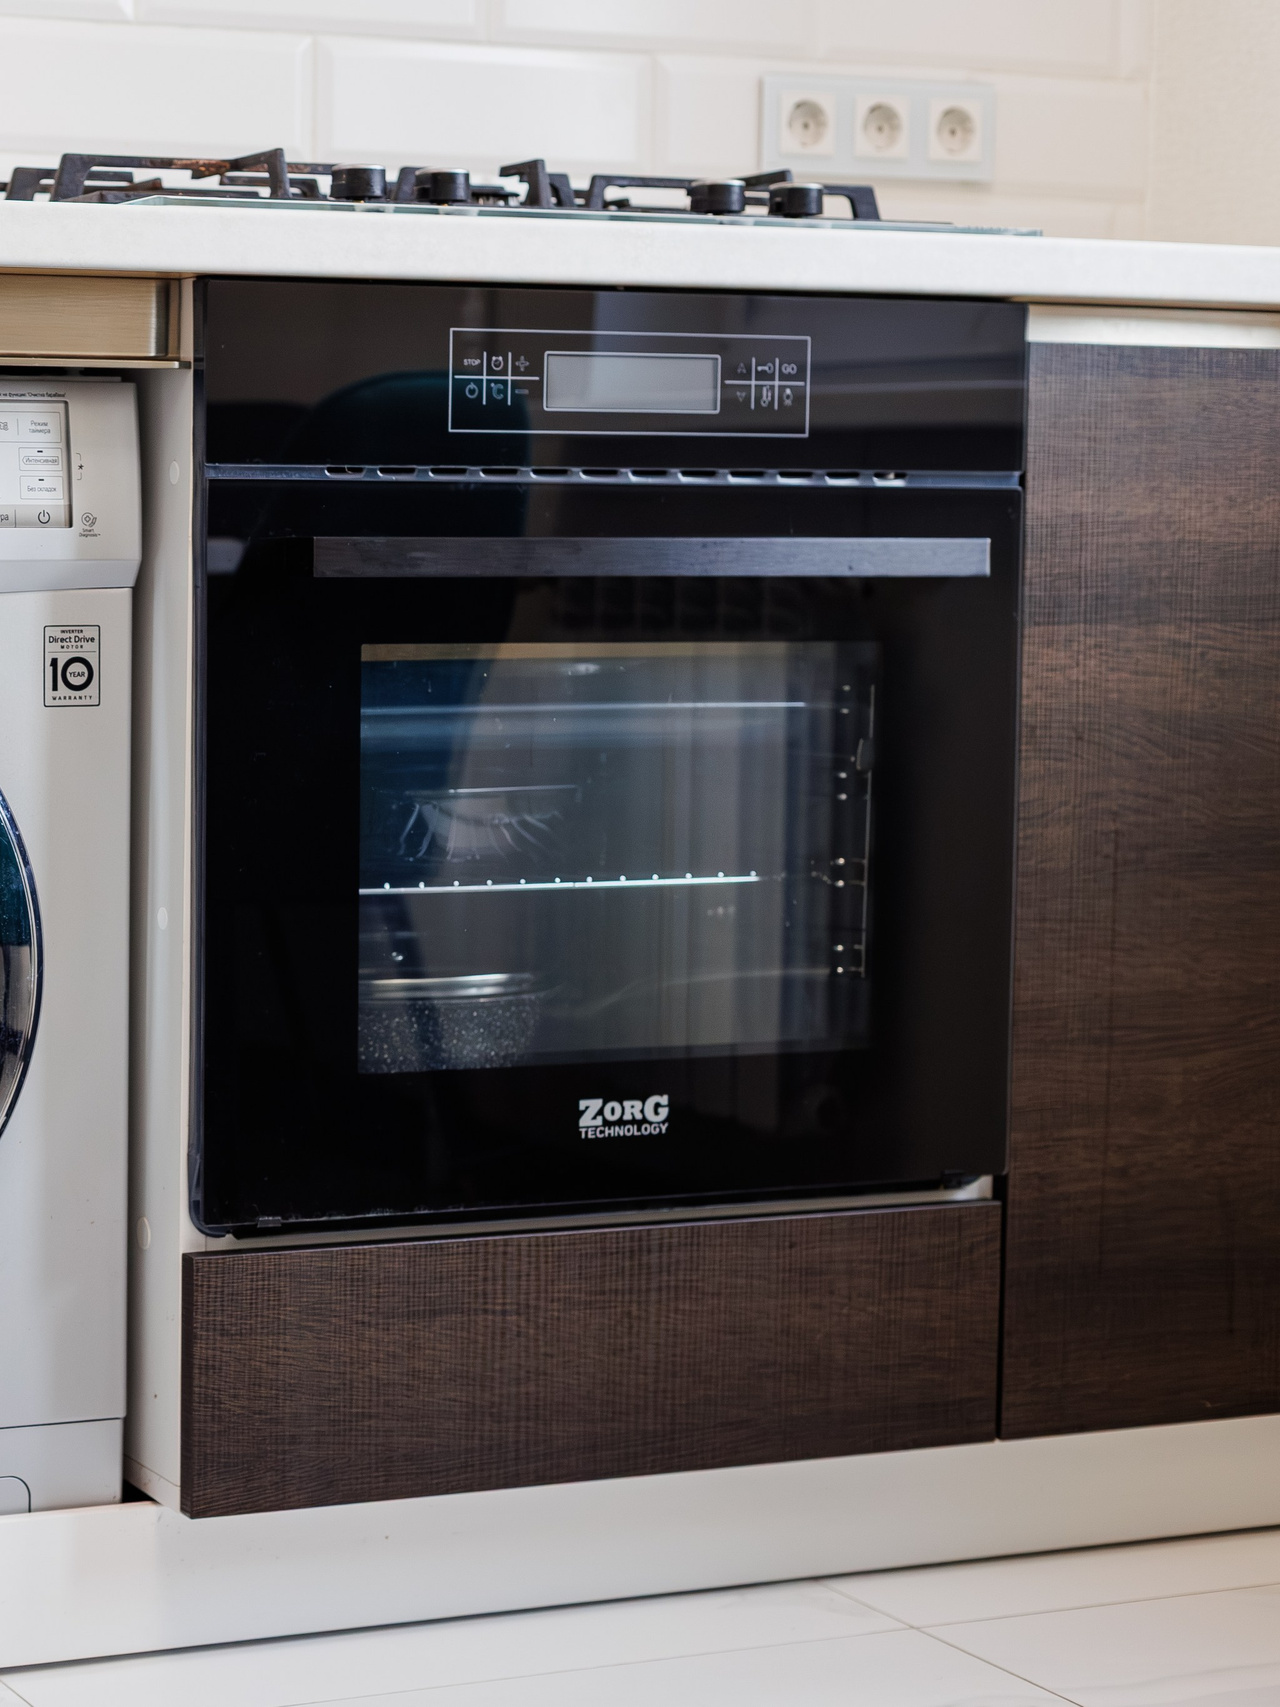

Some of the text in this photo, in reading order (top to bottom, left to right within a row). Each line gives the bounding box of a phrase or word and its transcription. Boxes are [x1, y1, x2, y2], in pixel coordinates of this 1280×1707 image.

[31, 419, 48, 427] Режим
[48, 635, 95, 643] Direct Drive
[49, 656, 94, 692] 10
[579, 1122, 669, 1139] TECHNOLOGY
